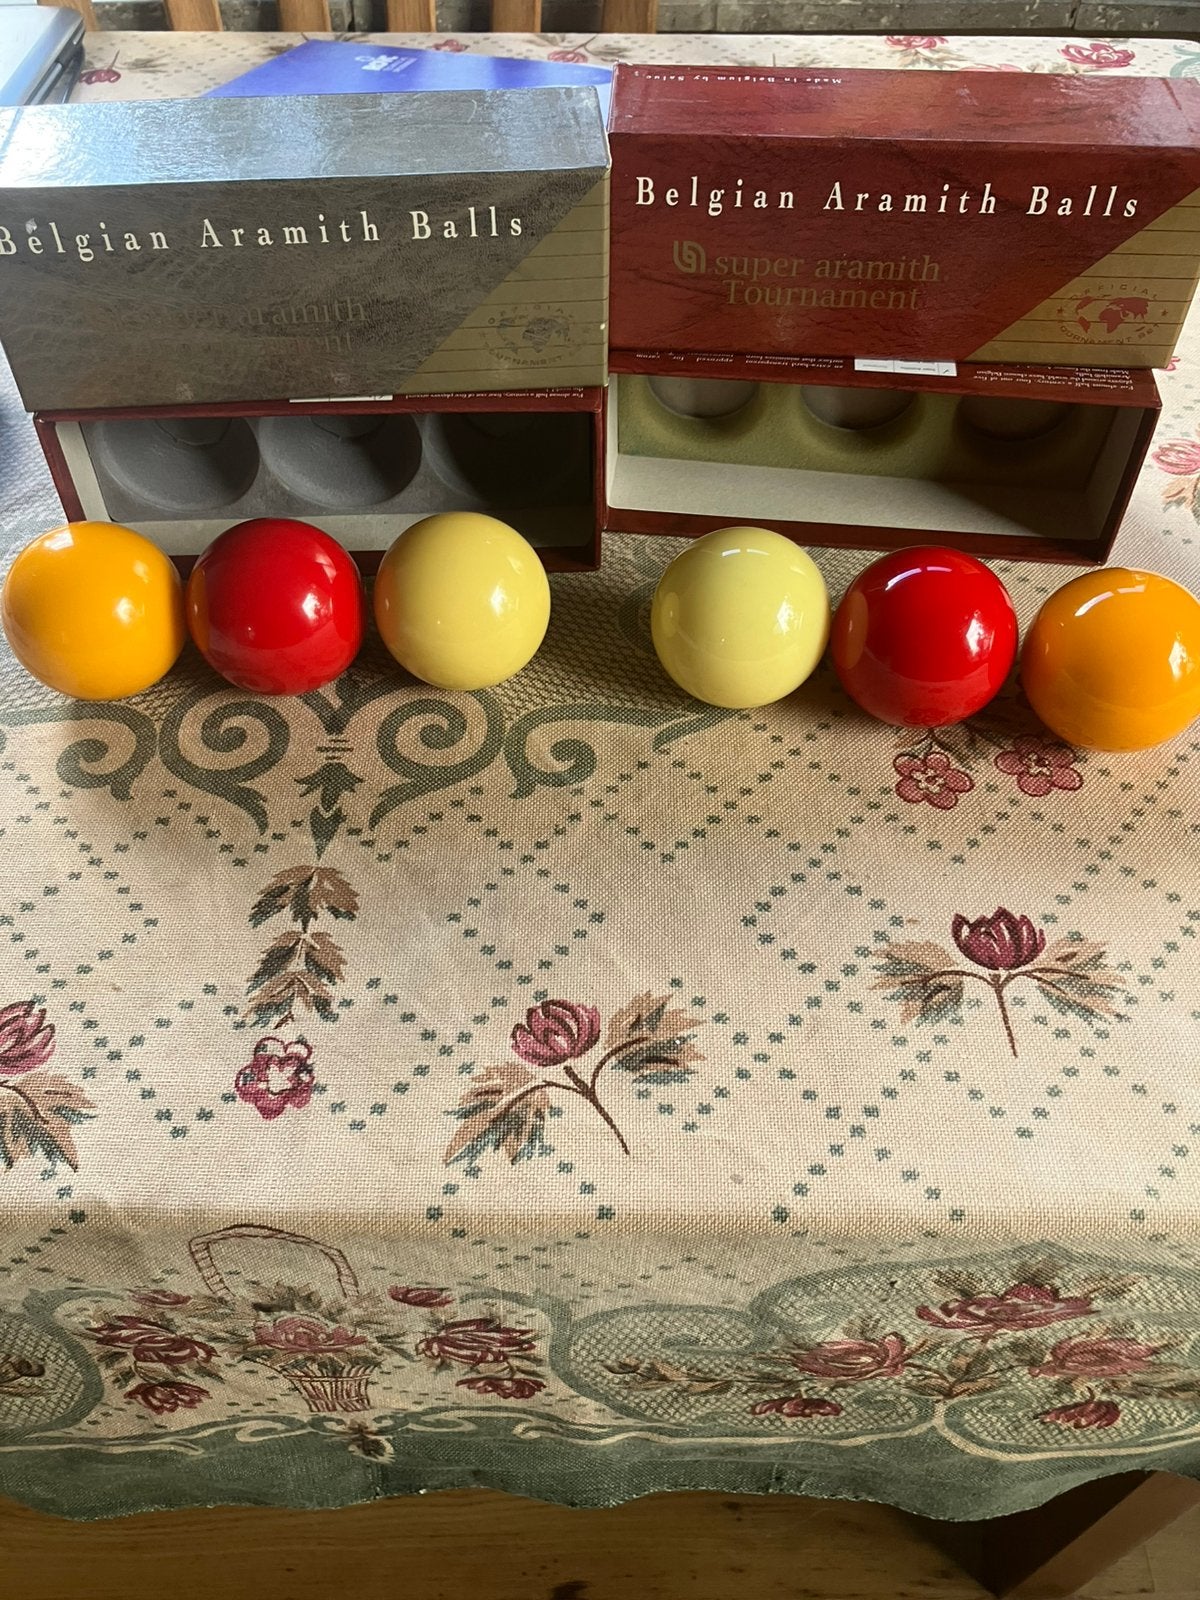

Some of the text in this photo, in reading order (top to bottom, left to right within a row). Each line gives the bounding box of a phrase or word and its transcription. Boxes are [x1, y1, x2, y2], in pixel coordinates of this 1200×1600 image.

[693, 74, 709, 82] by
[717, 75, 775, 84] Belgium
[635, 175, 1137, 217] Belgian Aramith Balls
[0, 206, 522, 262] Belgian Aramith Balls
[714, 255, 941, 282] super aramith
[722, 280, 920, 311] Tournament
